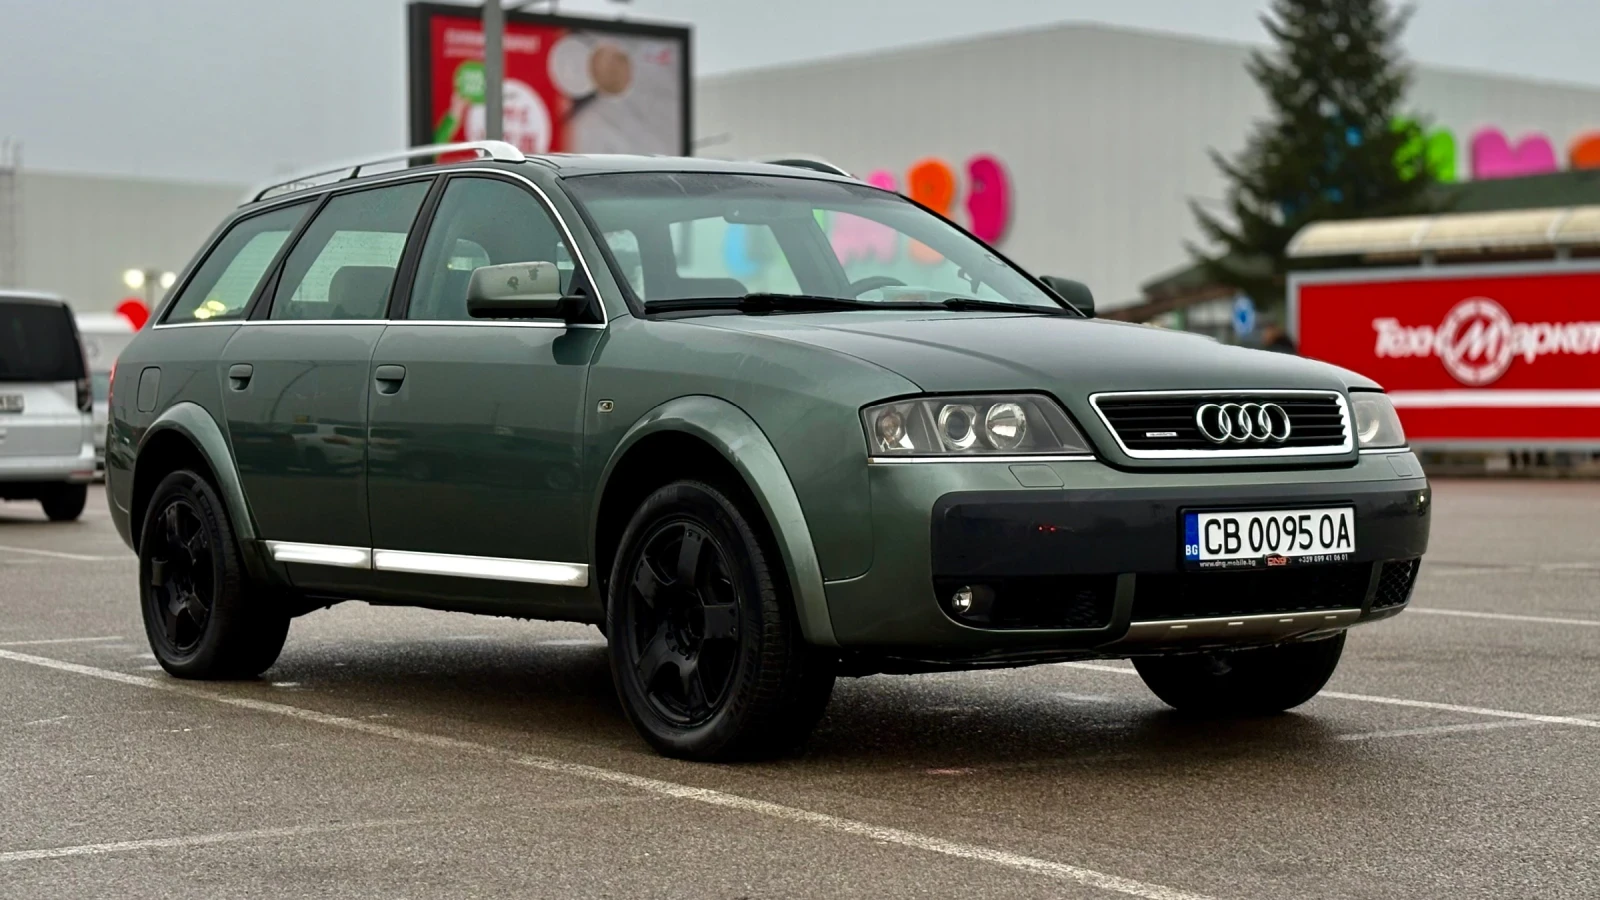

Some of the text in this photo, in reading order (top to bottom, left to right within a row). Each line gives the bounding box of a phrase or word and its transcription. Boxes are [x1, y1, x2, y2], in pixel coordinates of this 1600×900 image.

[1204, 513, 1351, 555] CB 0095 OA
[1185, 544, 1198, 556] BG
[1199, 558, 1256, 568] www.dng.mobile.bg
